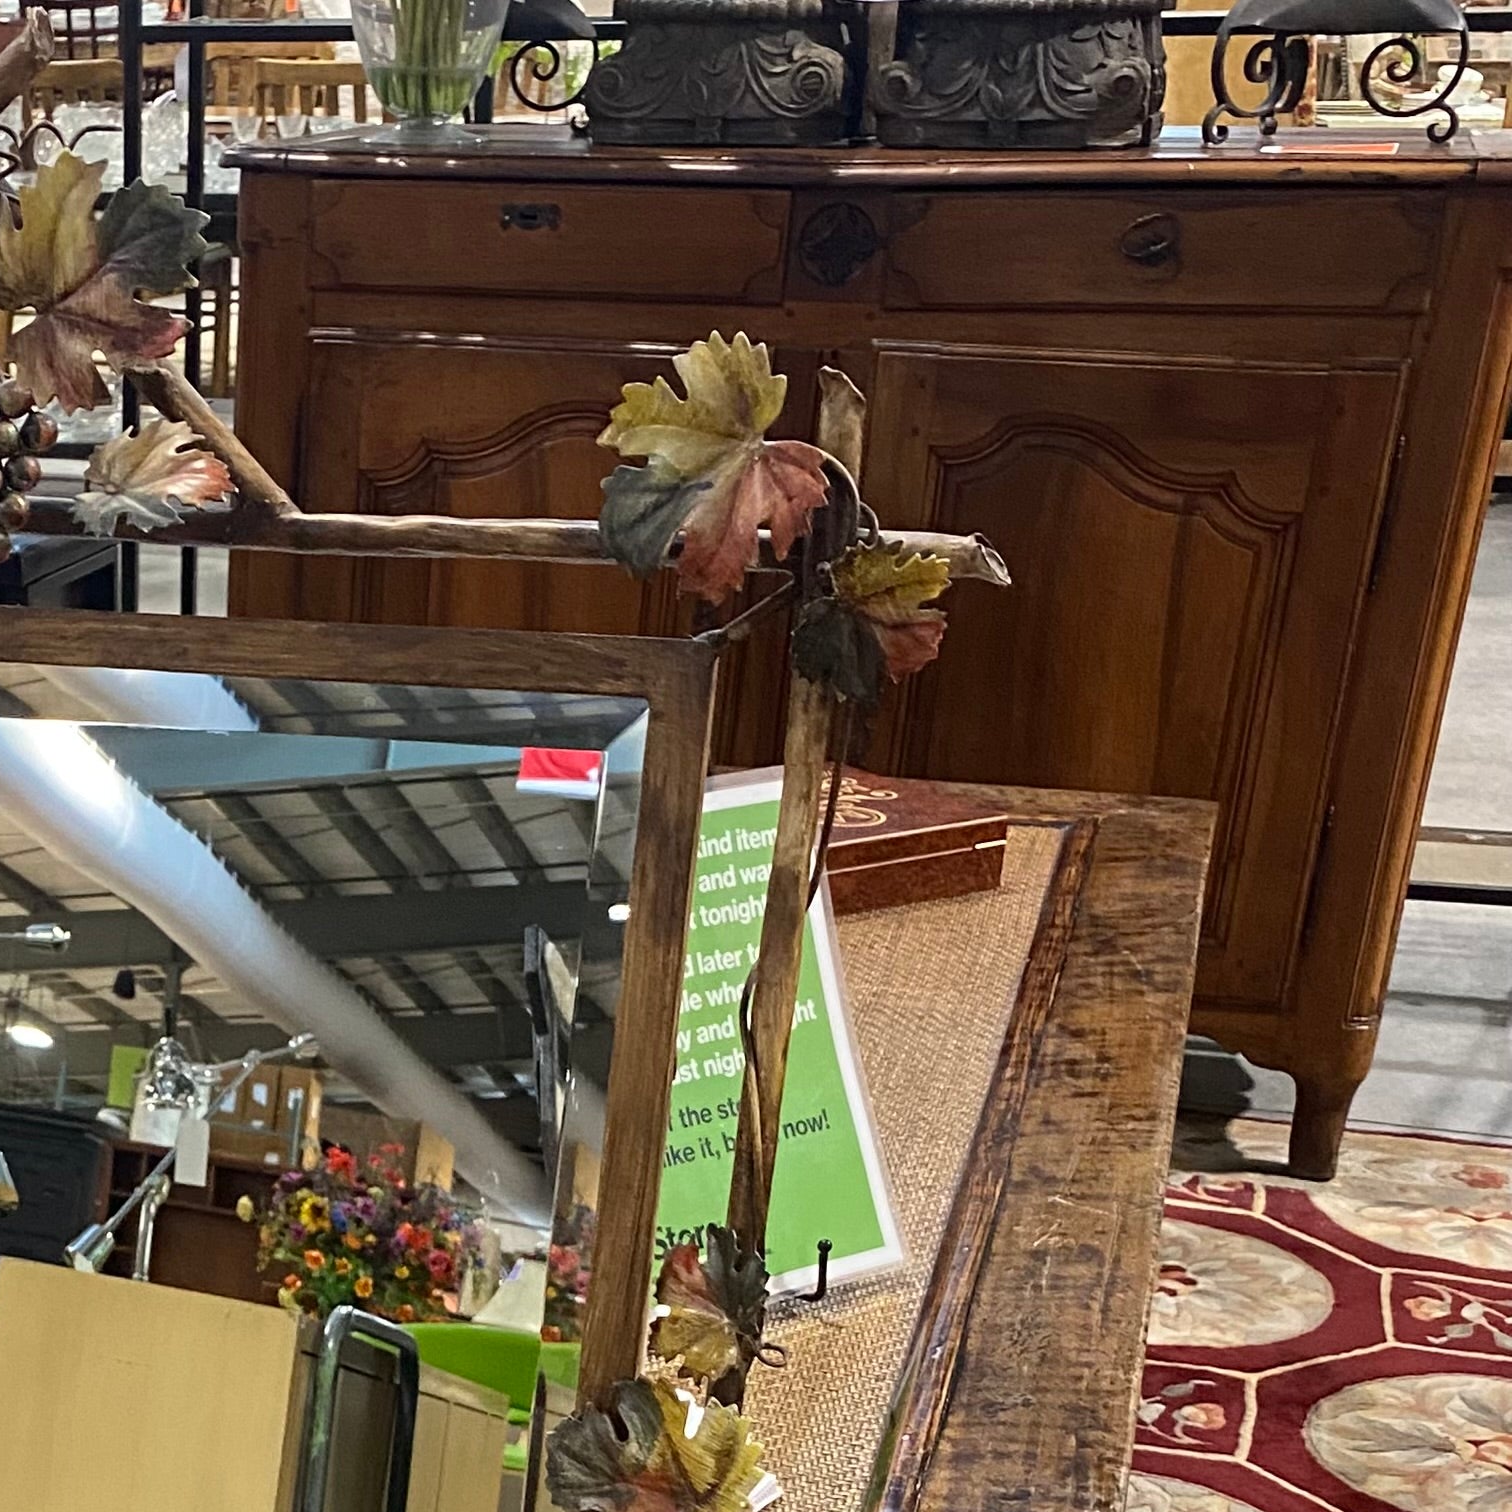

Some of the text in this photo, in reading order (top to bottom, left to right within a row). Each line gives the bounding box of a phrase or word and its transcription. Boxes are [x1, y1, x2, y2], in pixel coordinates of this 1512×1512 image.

[699, 864, 736, 893] and
[696, 948, 743, 975] later
[697, 1014, 735, 1044] and
[679, 1106, 712, 1128] the
[699, 1136, 721, 1160] it,
[782, 1108, 831, 1140] now!
